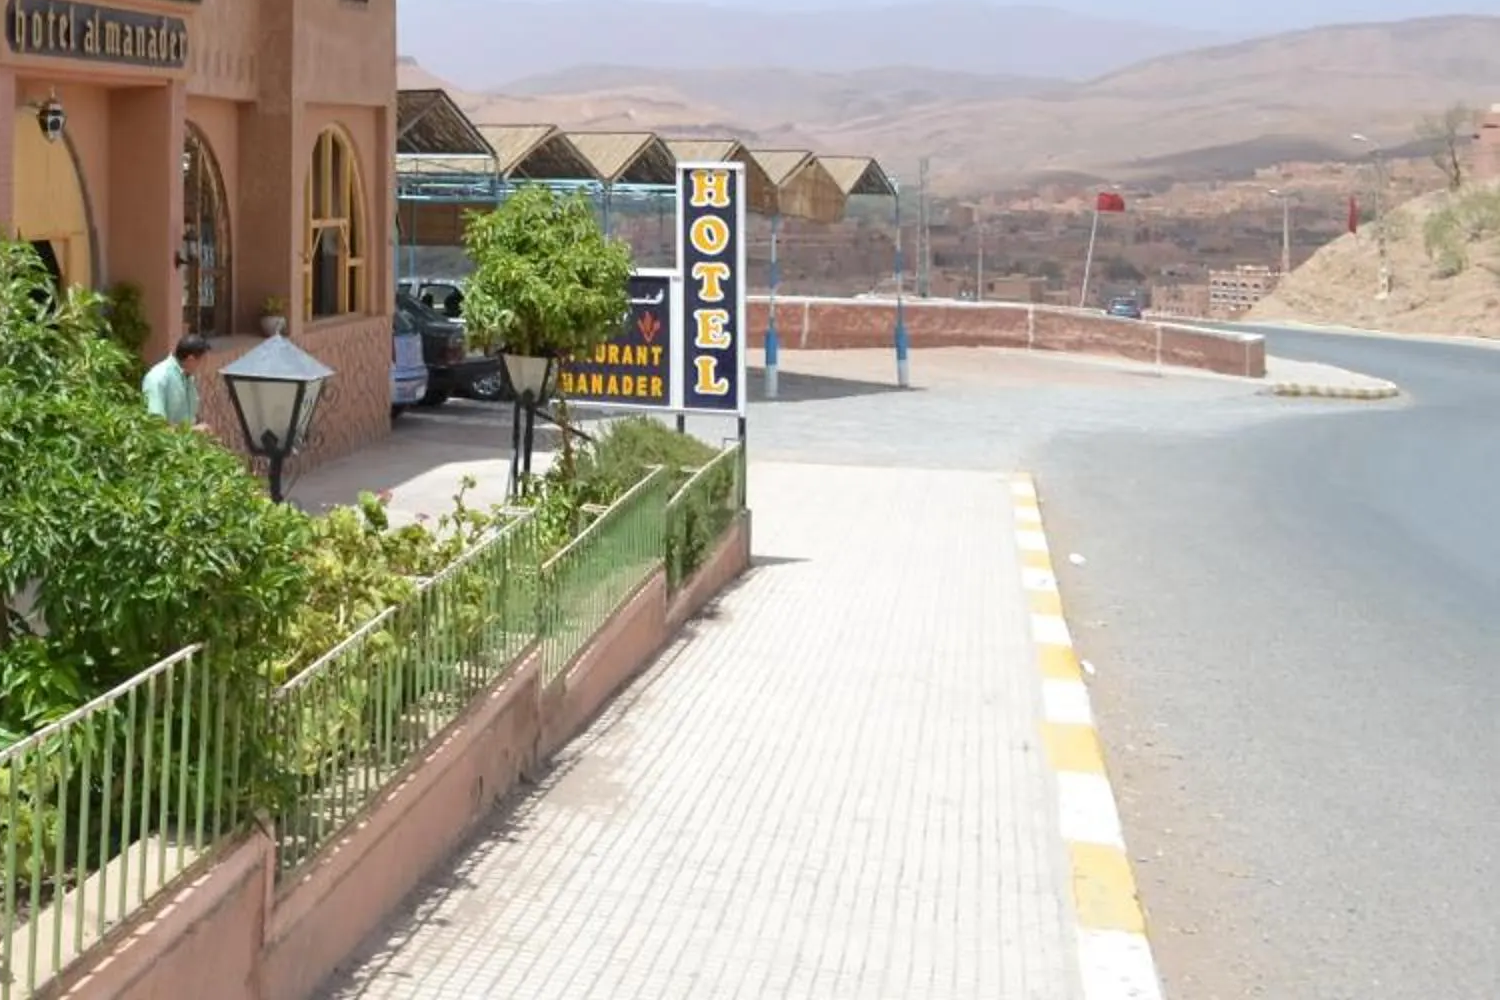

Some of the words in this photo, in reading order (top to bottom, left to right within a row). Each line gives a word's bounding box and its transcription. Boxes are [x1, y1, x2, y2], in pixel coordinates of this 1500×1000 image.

[84, 9, 100, 55] al
[105, 16, 186, 61] manader
[690, 169, 731, 395] HOTEL
[569, 344, 662, 366] URANT
